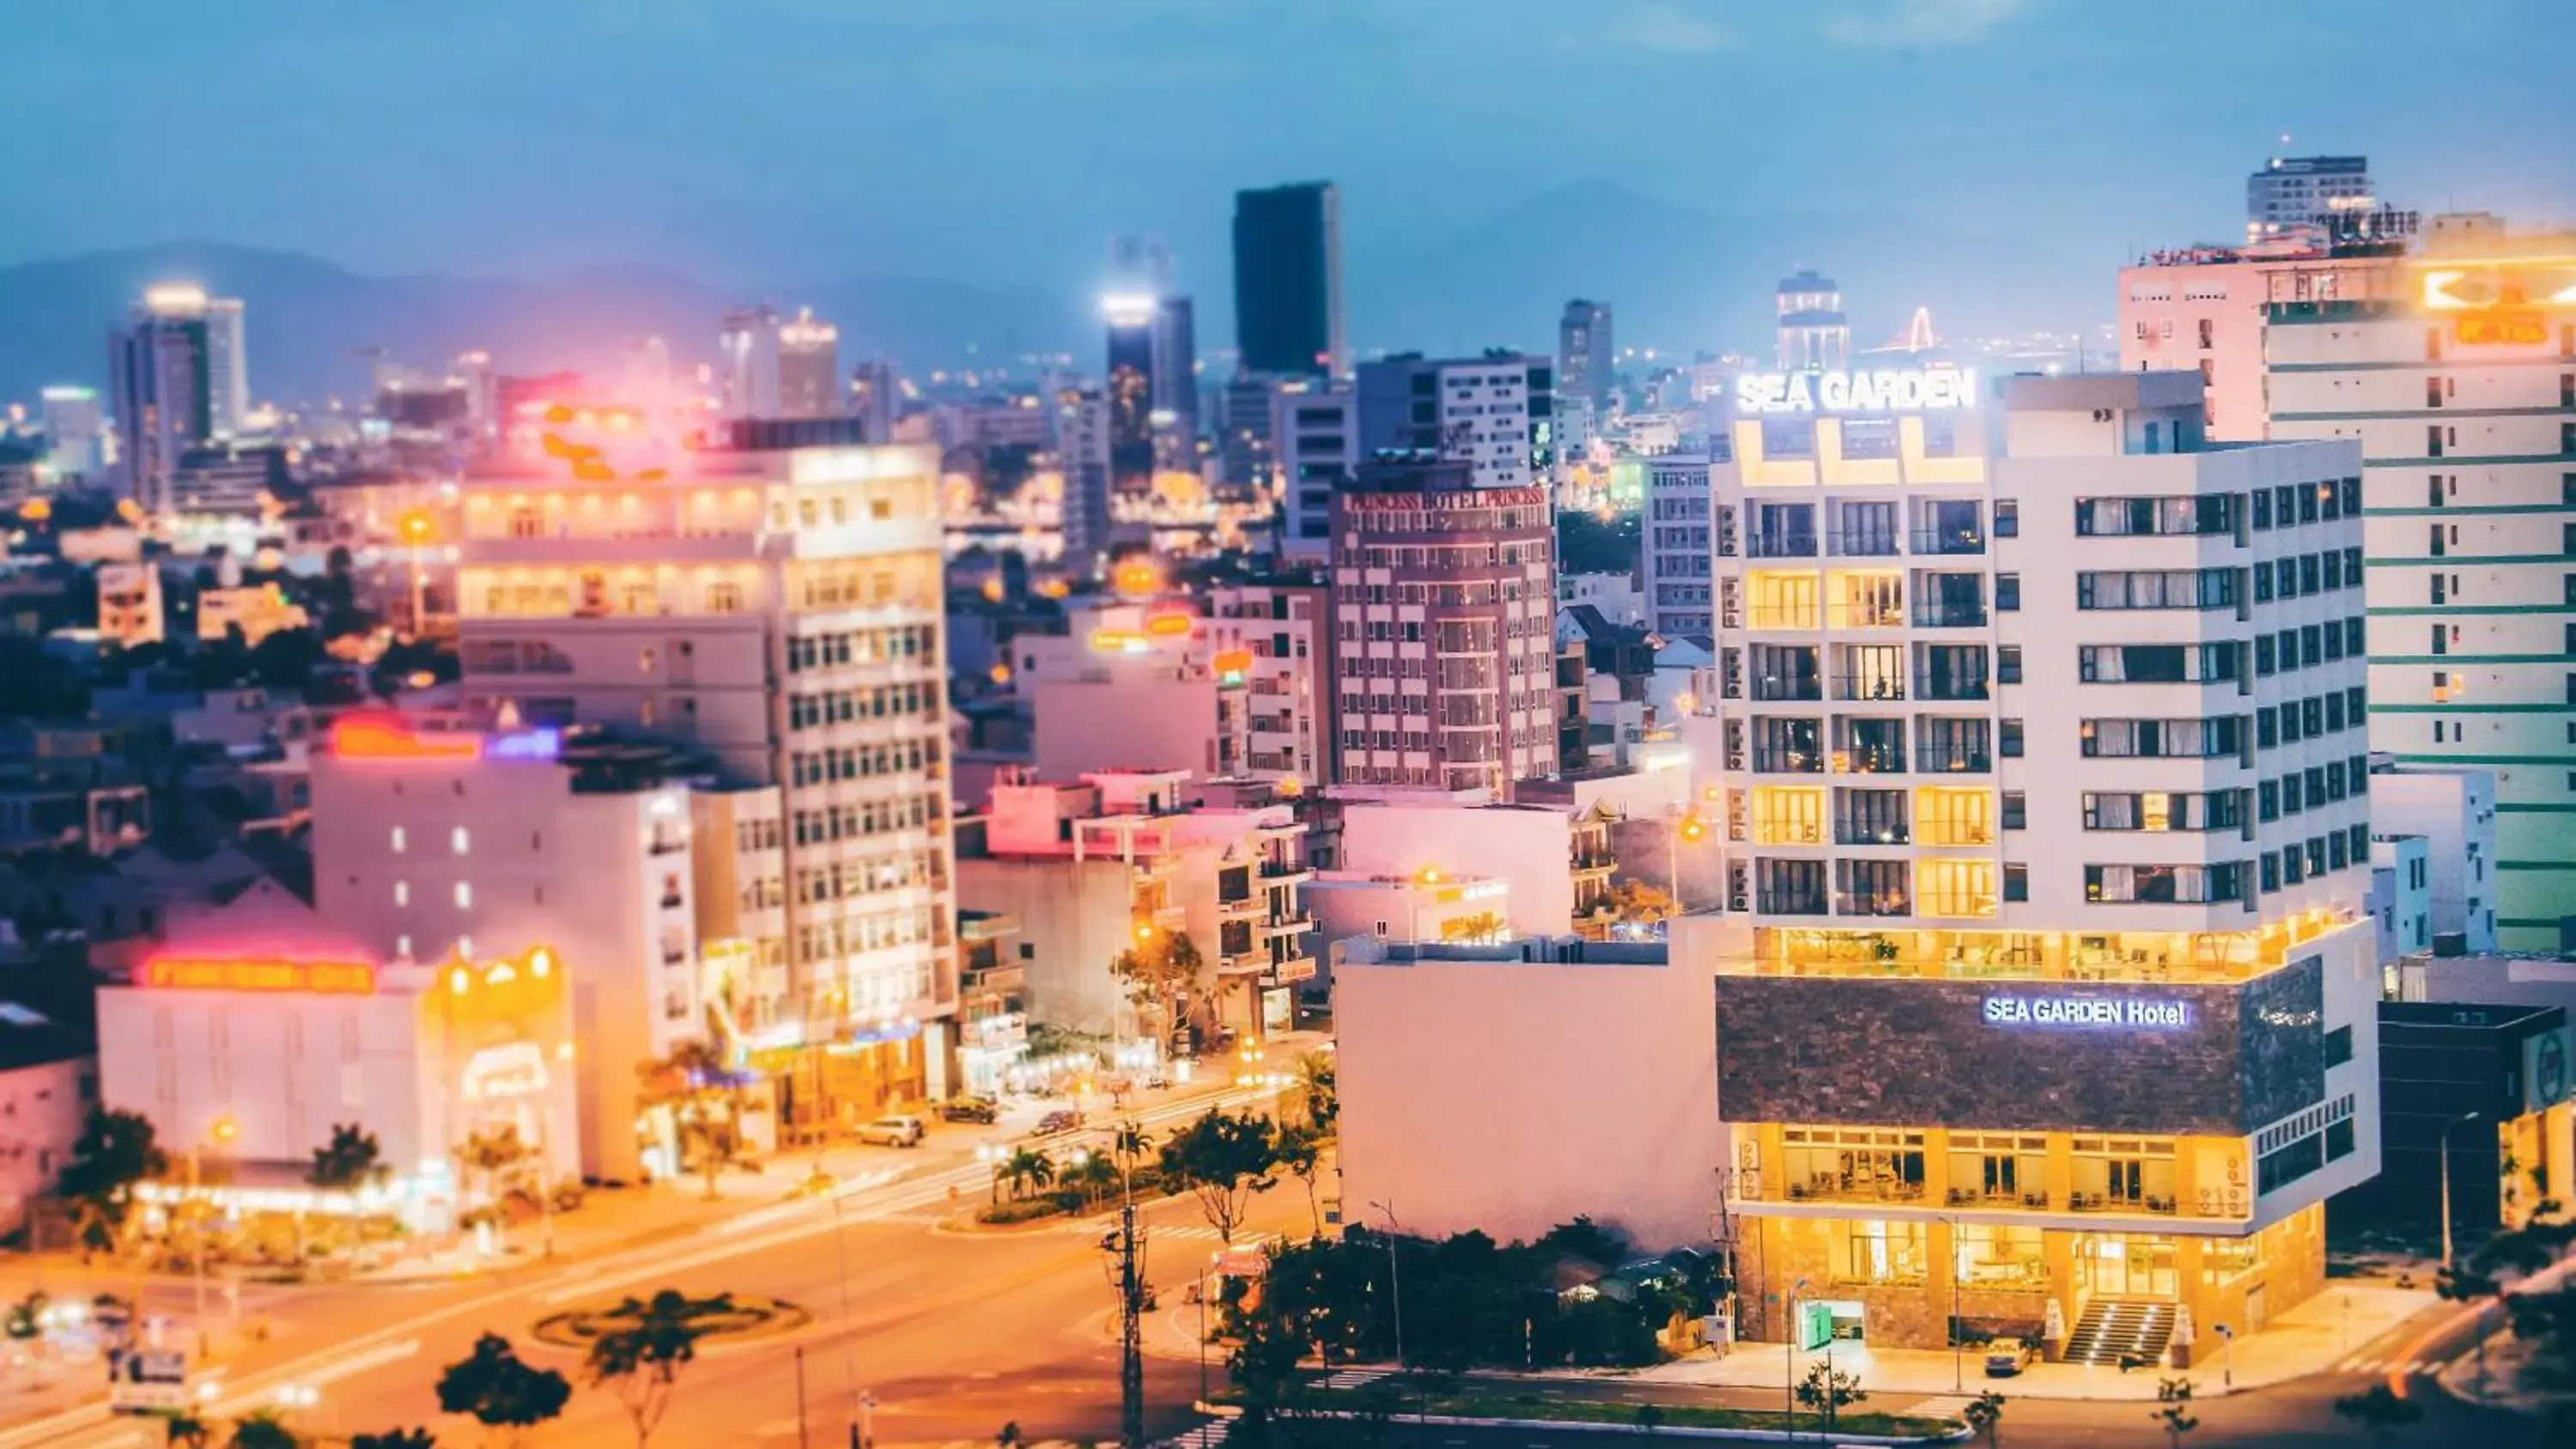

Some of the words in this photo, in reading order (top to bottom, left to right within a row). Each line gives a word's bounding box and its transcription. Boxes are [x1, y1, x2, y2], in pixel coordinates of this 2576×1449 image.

[1736, 373, 1814, 412] SEA
[1820, 368, 1976, 410] GARDEN
[1422, 491, 1484, 510] HOTEL
[1485, 487, 1545, 506] PRINCESS
[1985, 997, 2030, 1022] SEA
[2032, 999, 2122, 1024] GARDEN
[2127, 1001, 2186, 1026] Hotel
